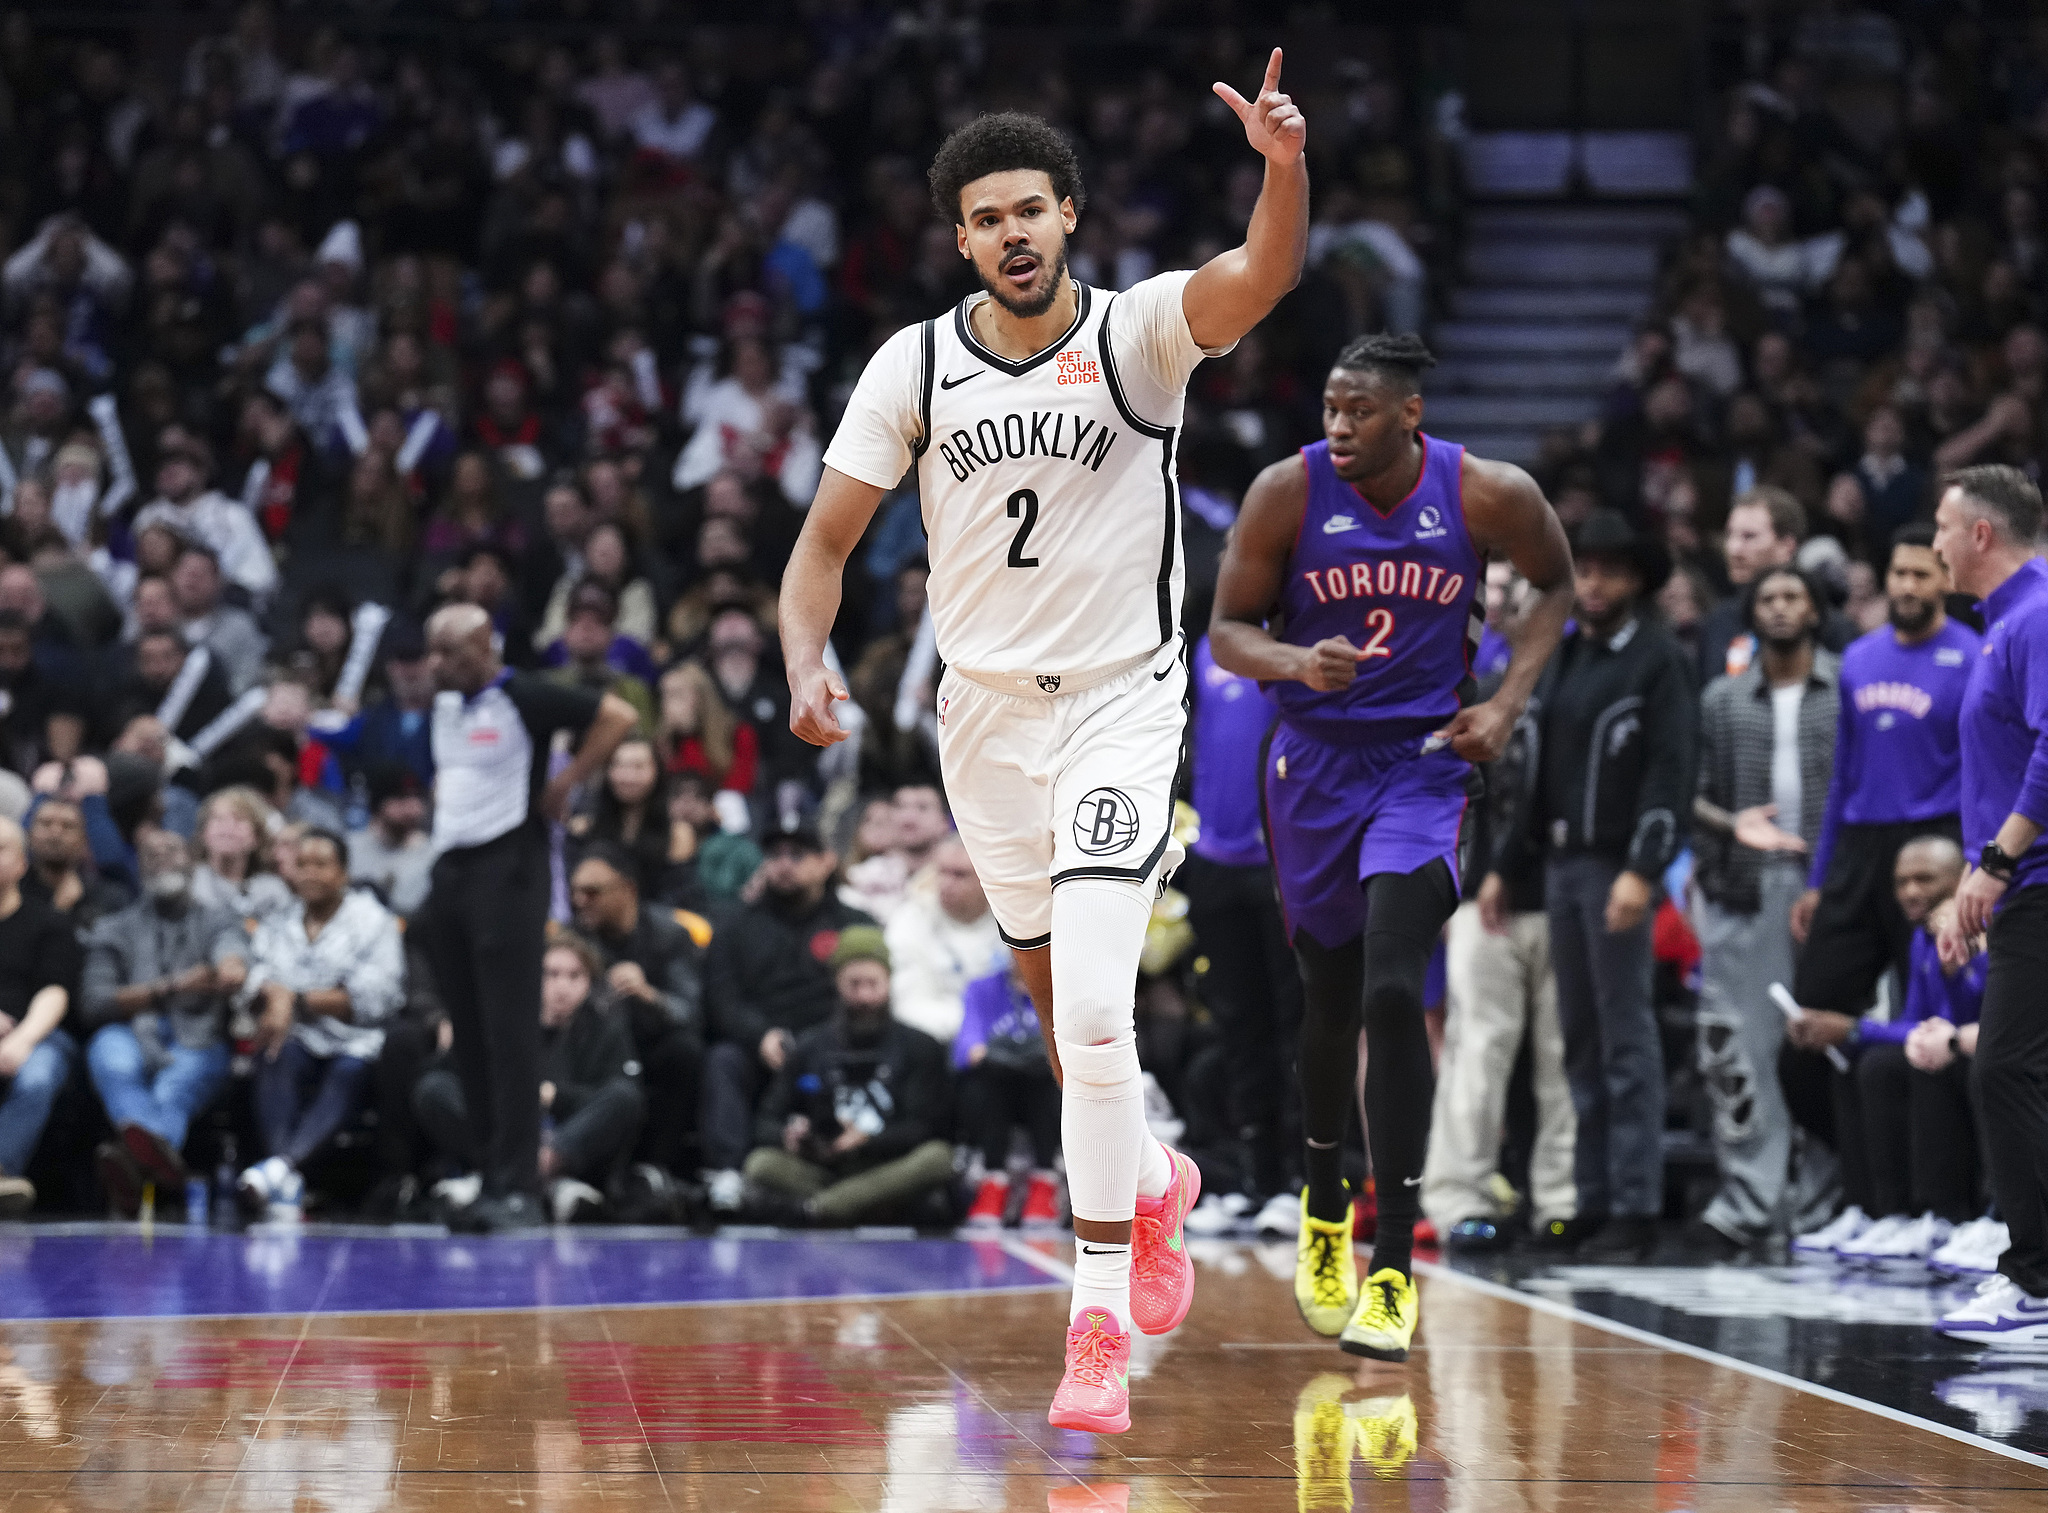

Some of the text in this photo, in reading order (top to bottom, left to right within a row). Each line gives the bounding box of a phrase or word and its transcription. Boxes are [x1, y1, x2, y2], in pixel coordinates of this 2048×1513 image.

[1056, 351, 1082, 362] GET
[1057, 361, 1097, 373] YOUR
[1057, 372, 1100, 385] GUIDE
[939, 411, 1118, 483] BROOKLYN
[1006, 488, 1039, 568] 2
[1304, 560, 1464, 605] TORONTO
[1364, 607, 1395, 659] 2
[1090, 798, 1117, 846] B
